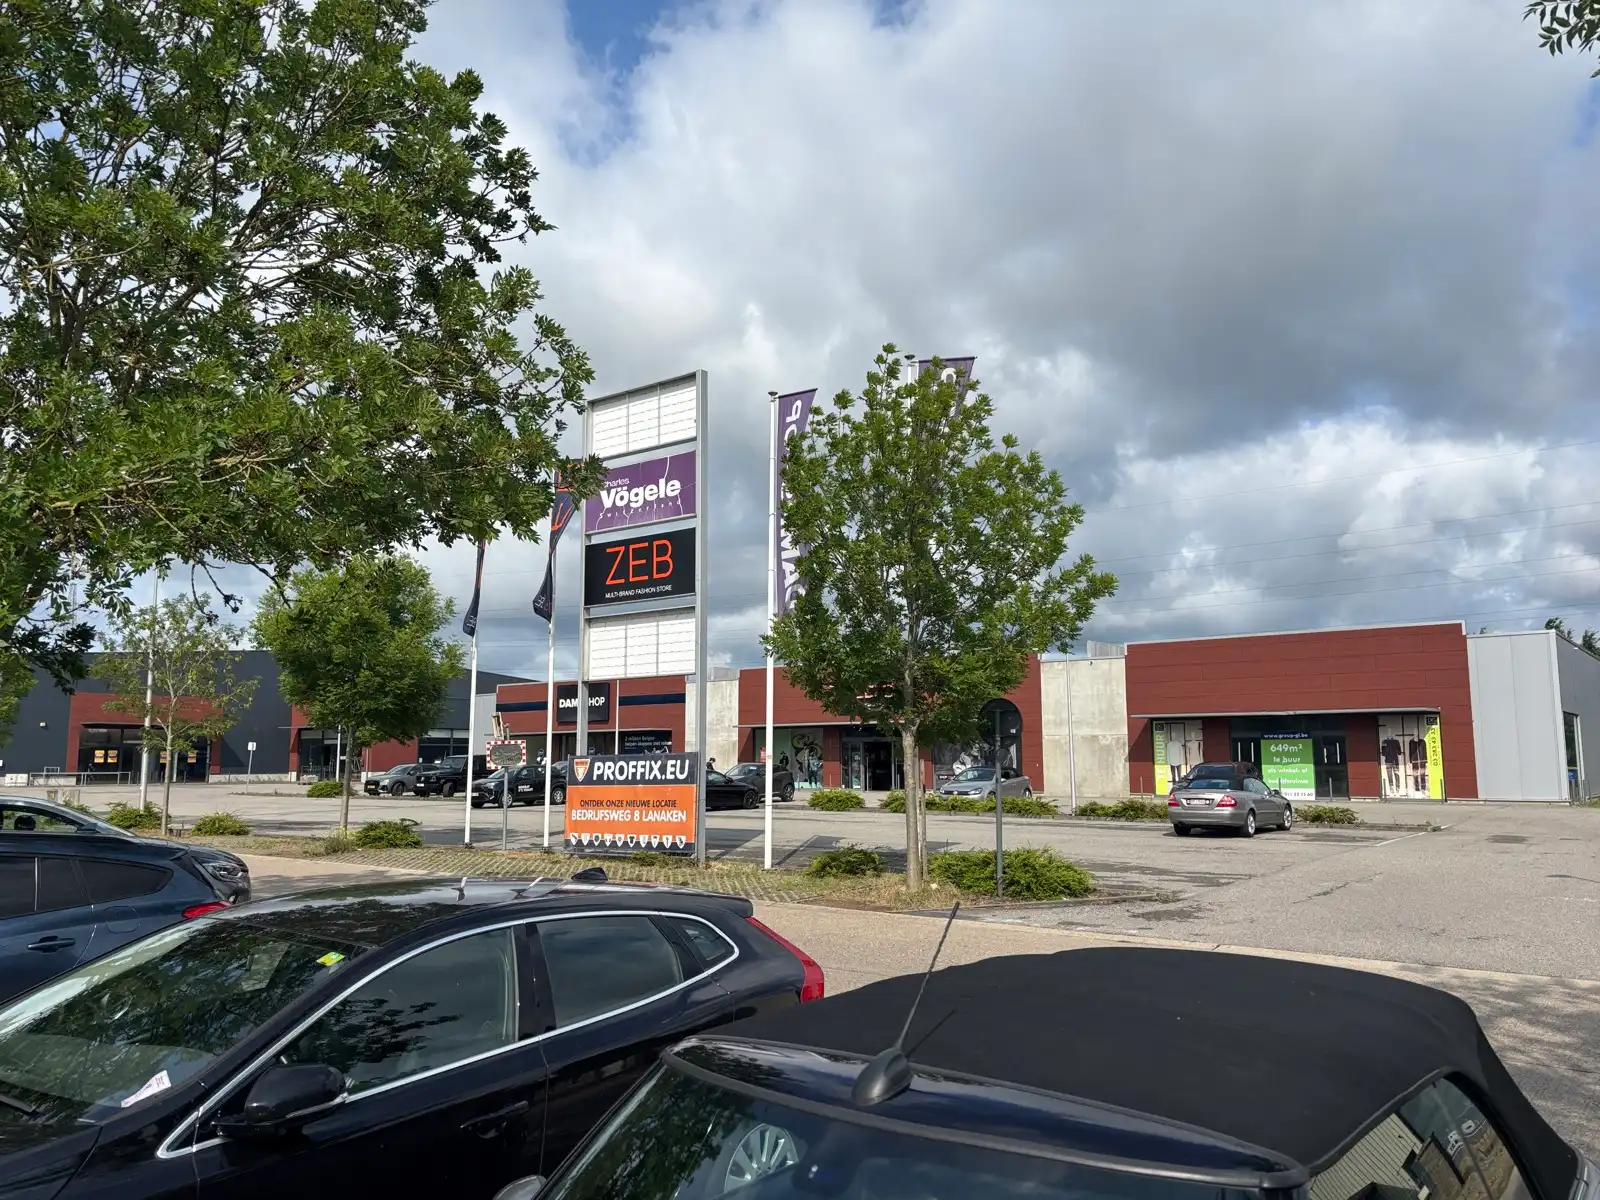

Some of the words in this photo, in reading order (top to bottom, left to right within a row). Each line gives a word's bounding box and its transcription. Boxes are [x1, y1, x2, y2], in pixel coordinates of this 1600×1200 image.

[600, 478, 681, 508] Vögele
[605, 539, 674, 585] ZEB
[605, 589, 636, 599] MULTI-BRAND
[636, 586, 656, 595] FASHION
[656, 584, 673, 593] STORE
[559, 697, 606, 708] DAMHOP
[1156, 734, 1165, 764] HUUR
[1282, 755, 1301, 763] huur
[593, 759, 689, 780] PROFFIX.EU
[580, 799, 604, 807] ONTDEK
[605, 799, 624, 807] ONZE
[652, 799, 677, 808] LOCATIE
[571, 809, 631, 821] BEDRIJFSWEG
[633, 810, 640, 821] 8
[642, 810, 687, 822] LANAKEN
